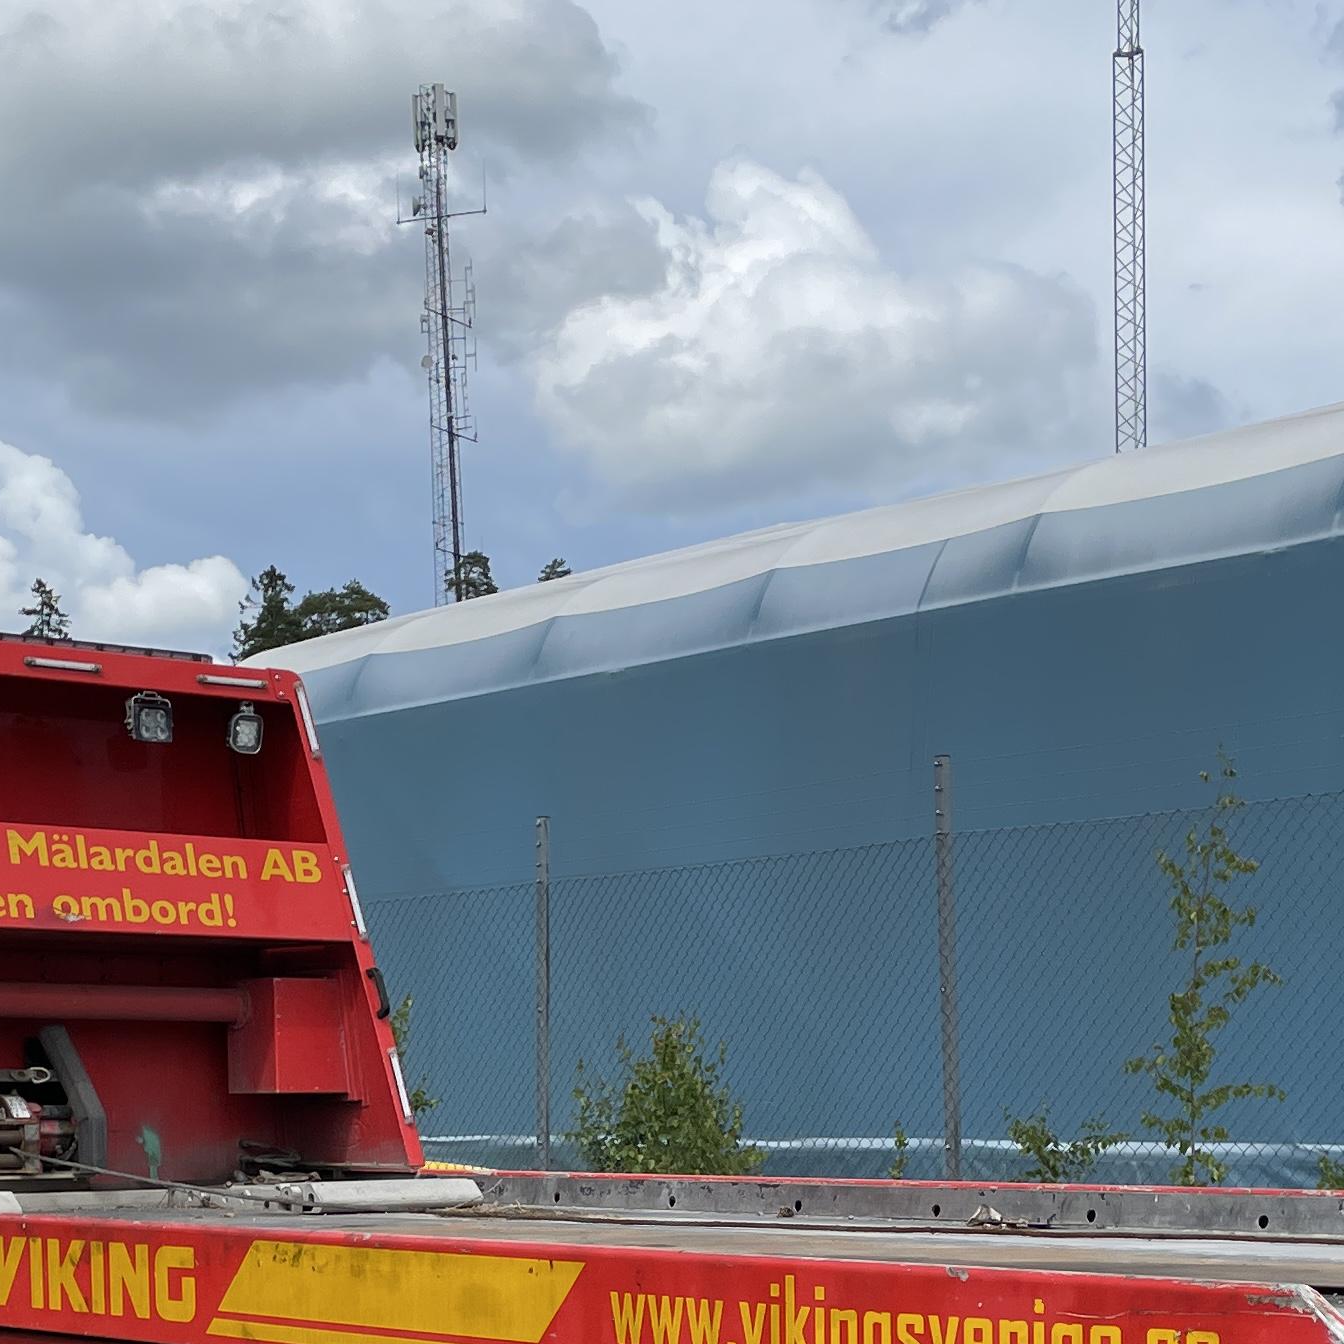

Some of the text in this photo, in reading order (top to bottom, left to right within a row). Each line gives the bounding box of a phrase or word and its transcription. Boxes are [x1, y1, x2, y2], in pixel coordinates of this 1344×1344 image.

[7, 829, 247, 879] Mälardalen
[261, 848, 322, 883] AB
[53, 888, 237, 928] ombord!
